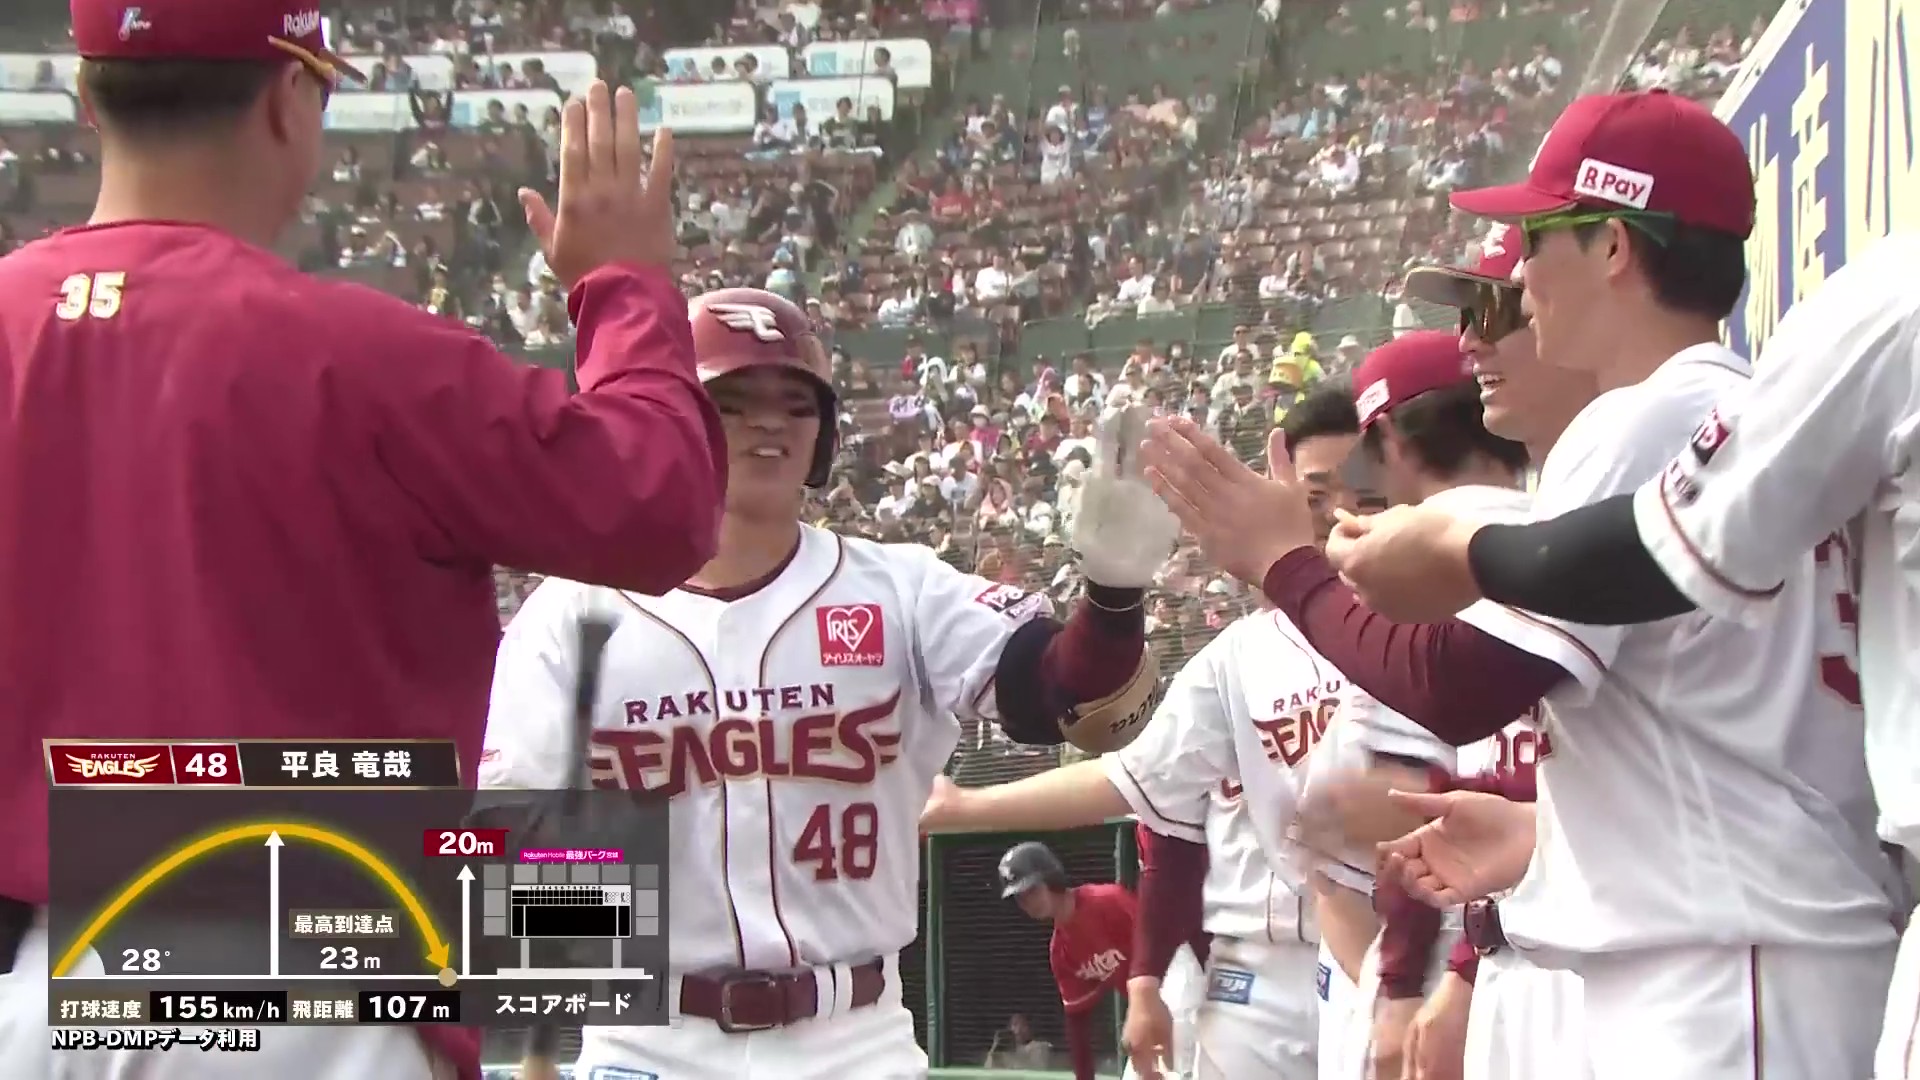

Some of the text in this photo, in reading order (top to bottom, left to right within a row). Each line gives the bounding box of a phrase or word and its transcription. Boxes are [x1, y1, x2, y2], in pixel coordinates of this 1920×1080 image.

[1601, 172, 1646, 201] Pay
[56, 271, 125, 319] 35
[624, 683, 835, 726] RAKUTEN
[1273, 679, 1351, 714] RAKU
[588, 688, 901, 801] EAGLES
[794, 803, 878, 880] 48
